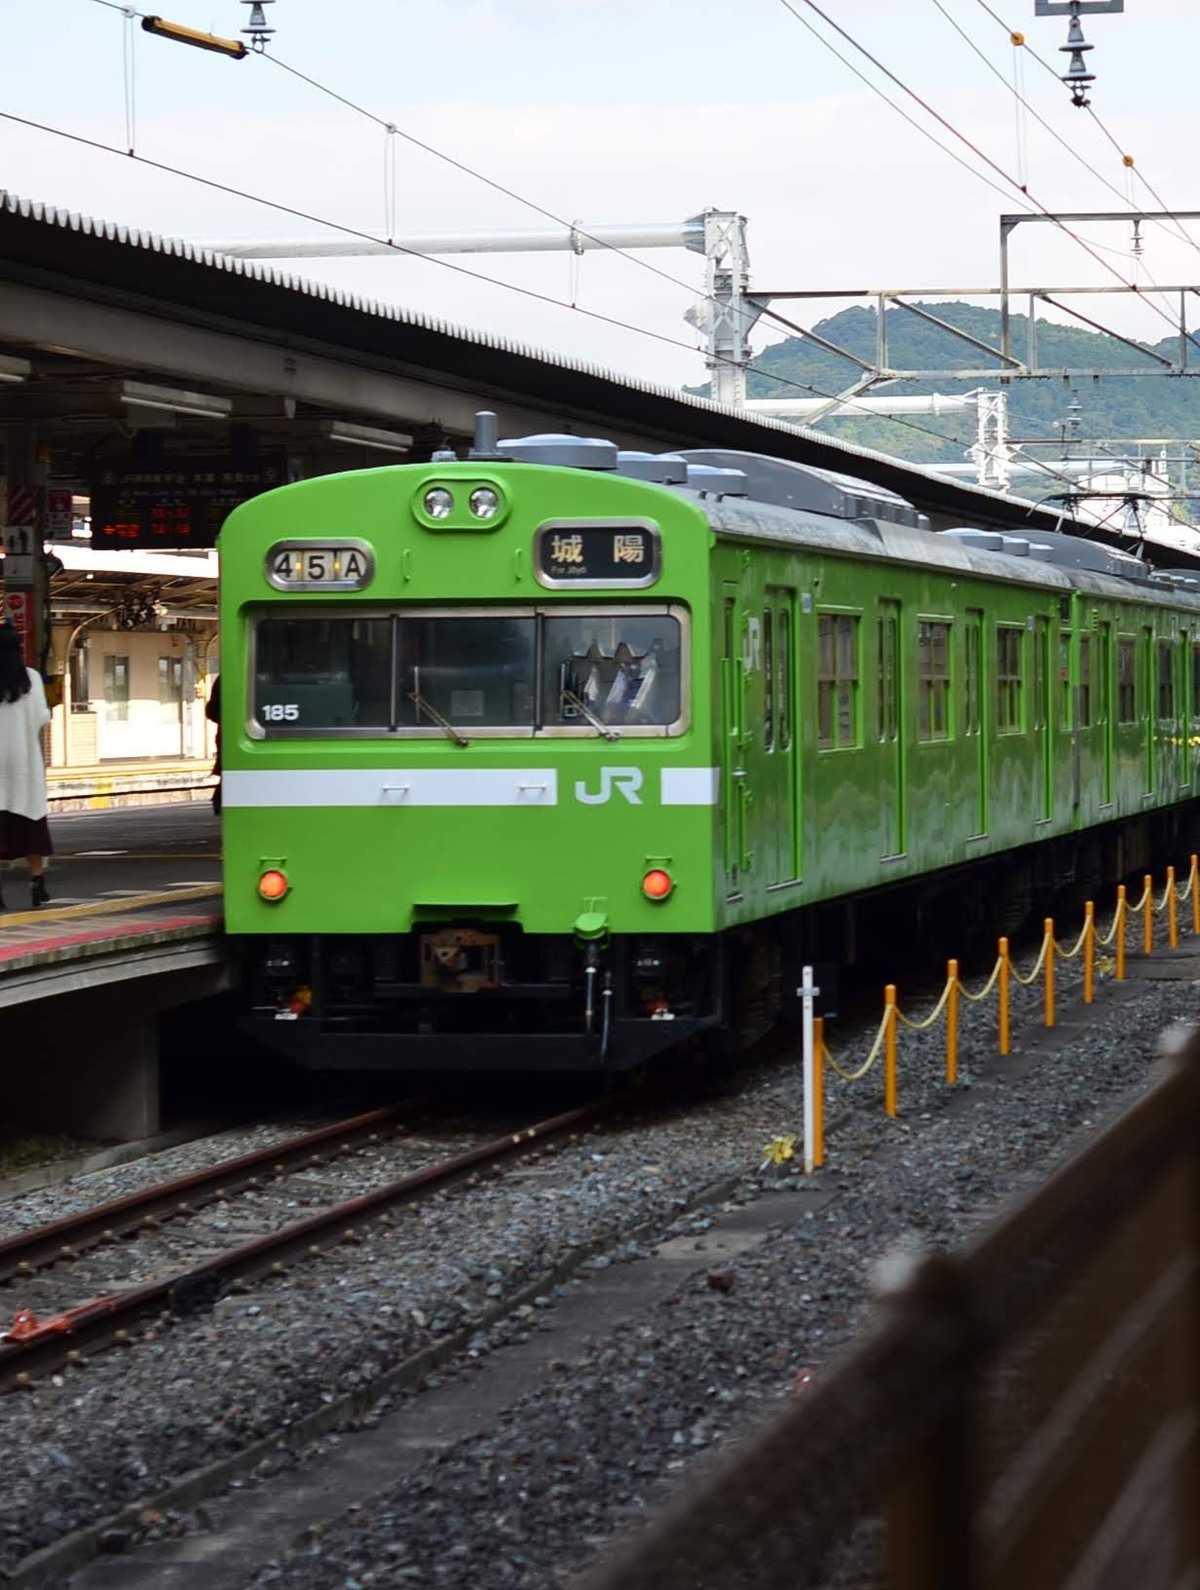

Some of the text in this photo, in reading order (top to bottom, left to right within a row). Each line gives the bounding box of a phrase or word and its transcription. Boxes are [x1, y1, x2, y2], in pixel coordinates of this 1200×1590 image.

[551, 534, 645, 563] 城陽
[275, 552, 363, 580] 45A
[262, 704, 299, 721] 185
[574, 766, 644, 805] JR
